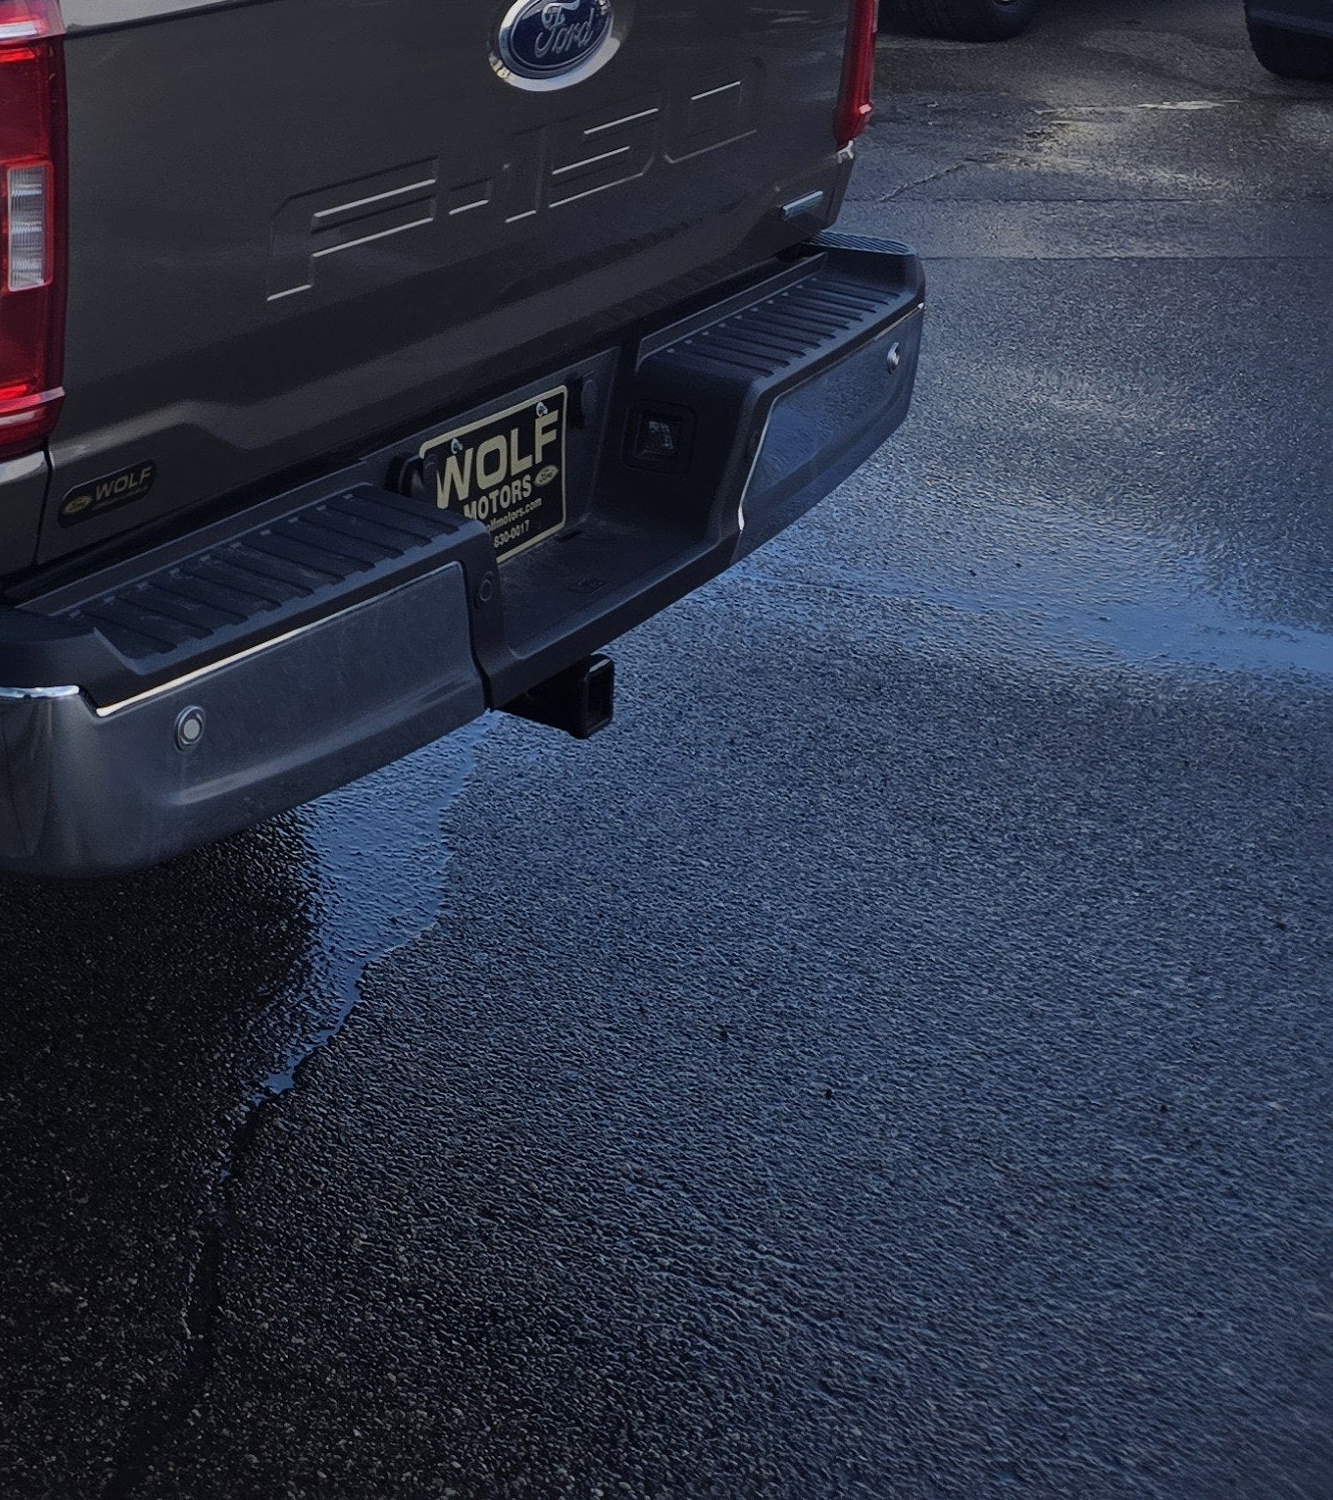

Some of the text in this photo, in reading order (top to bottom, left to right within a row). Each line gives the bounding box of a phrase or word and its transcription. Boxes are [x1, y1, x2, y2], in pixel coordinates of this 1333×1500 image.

[535, 0, 594, 59] Ford
[267, 58, 765, 301] F-150
[96, 466, 152, 501] WOLF
[436, 409, 559, 510] WOLF
[464, 474, 531, 520] MOTORS
[486, 498, 542, 531] olfmotors.com
